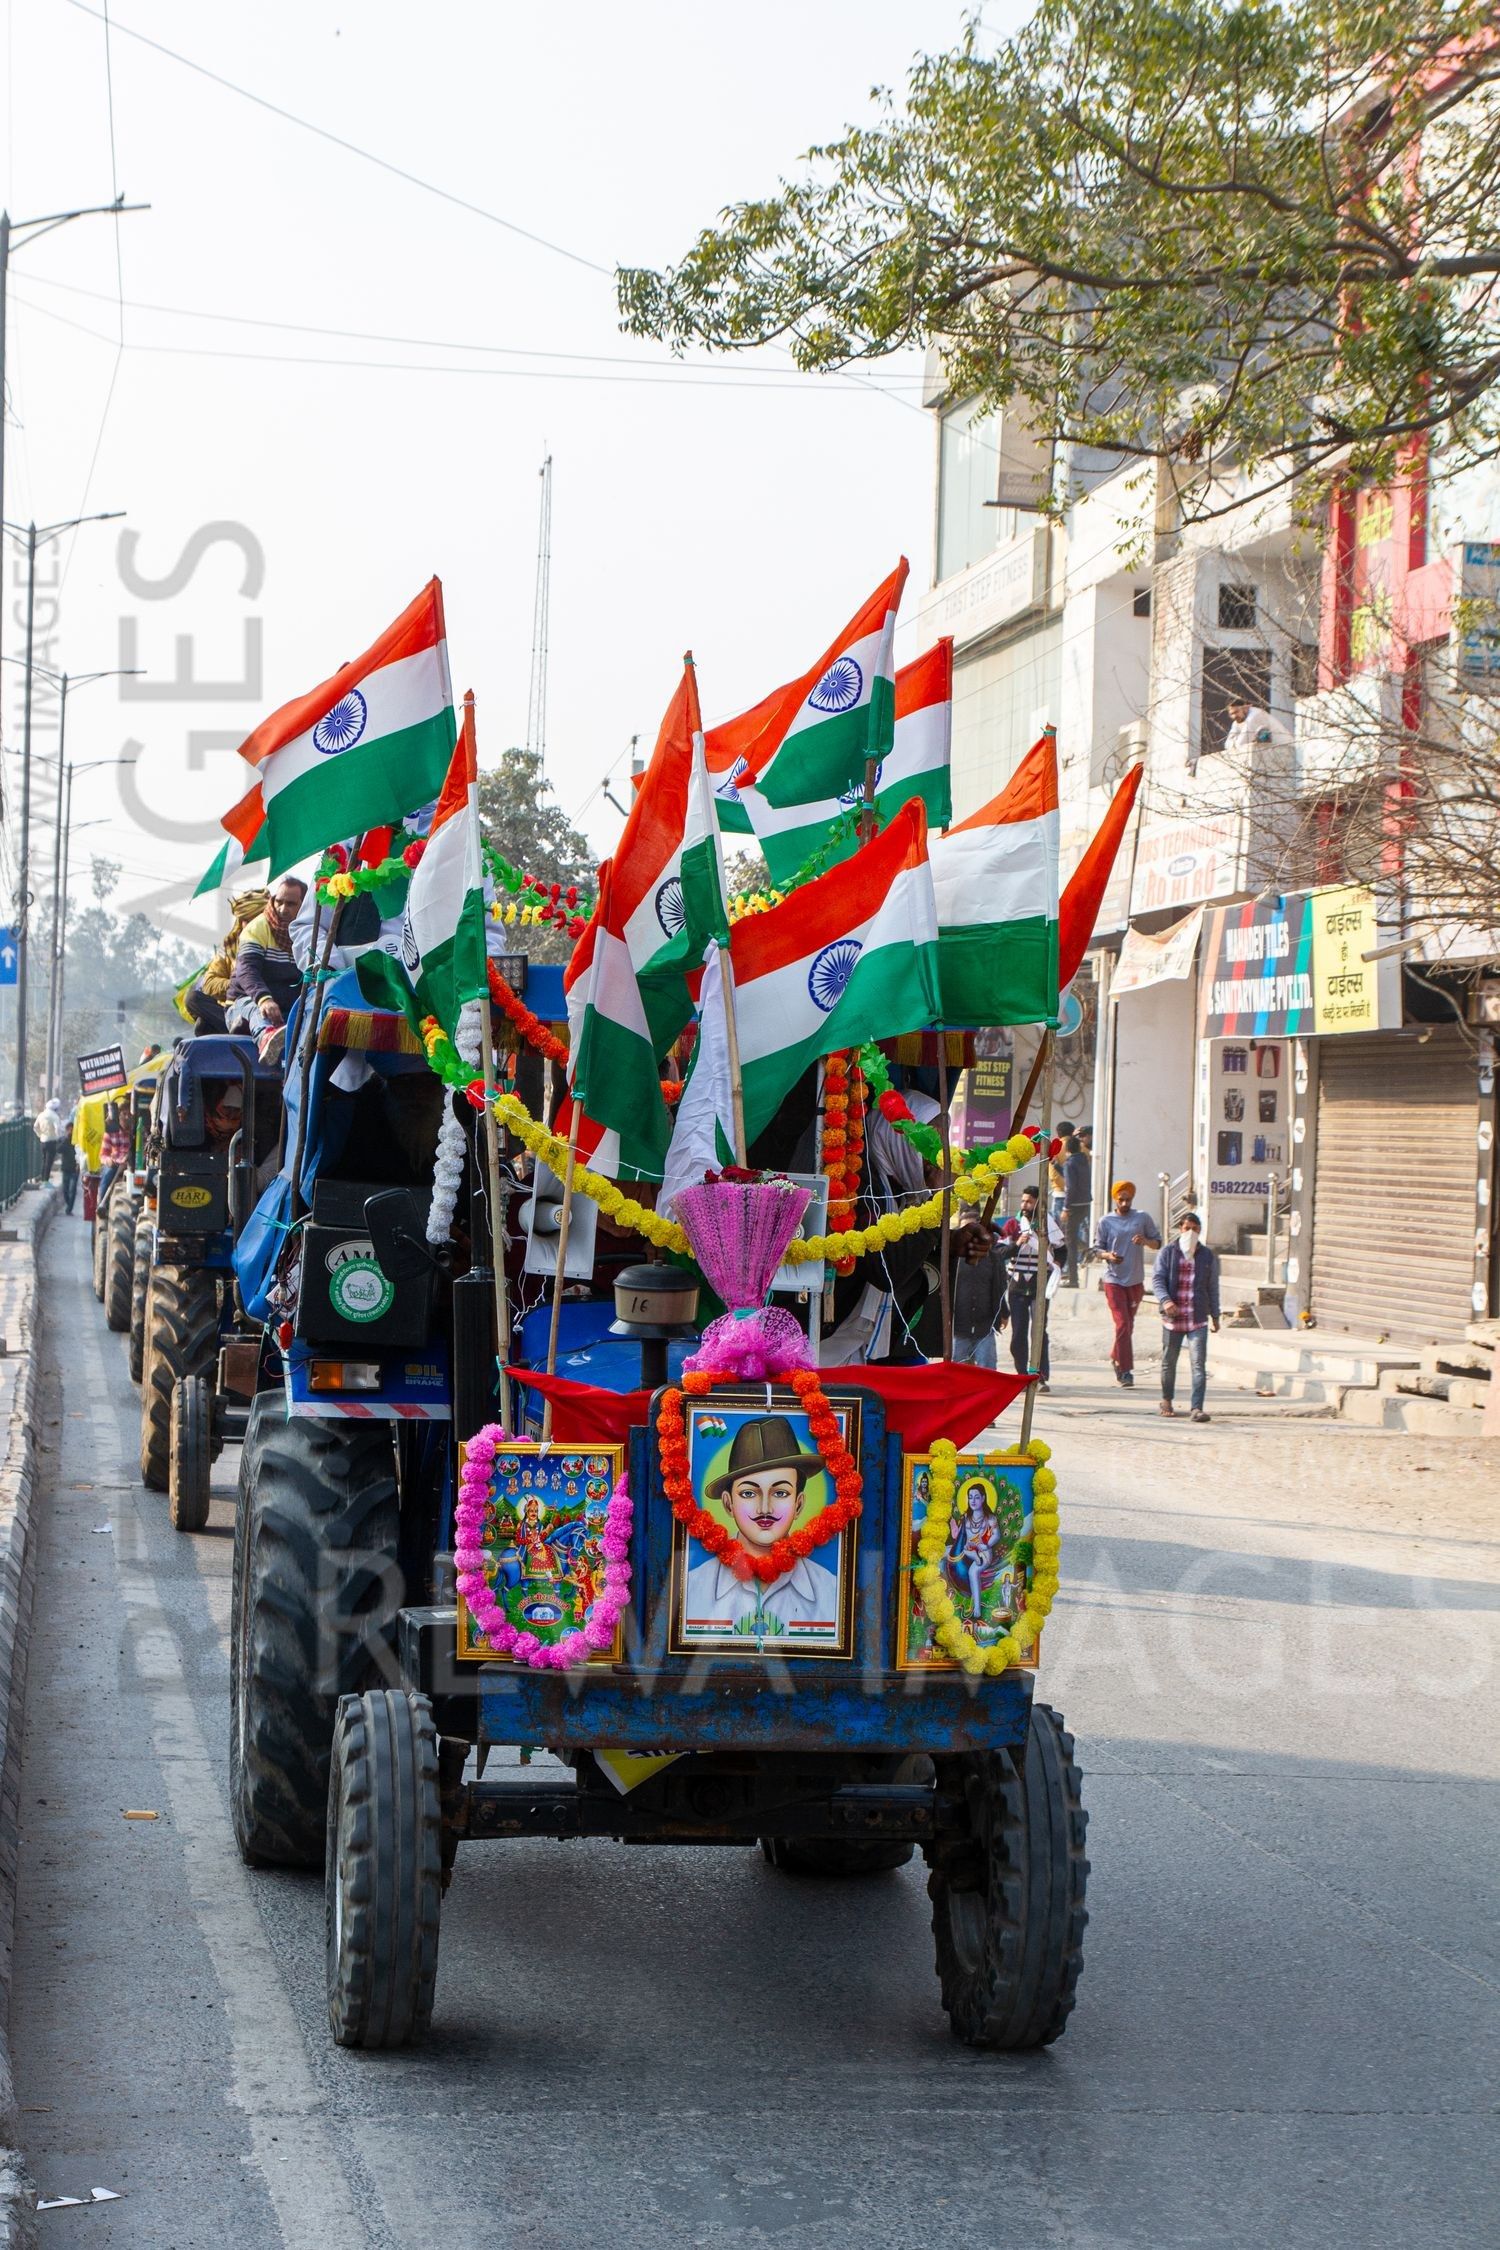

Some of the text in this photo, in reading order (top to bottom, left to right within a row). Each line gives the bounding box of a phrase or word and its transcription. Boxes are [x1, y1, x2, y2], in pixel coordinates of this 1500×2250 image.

[1265, 921, 1290, 959] TILES
[80, 1051, 121, 1071] WITHDRAW
[976, 1061, 1011, 1073] IRST STEP
[96, 1064, 121, 1077] FARMING
[975, 1074, 1005, 1087] FITNESS
[176, 1191, 206, 1201] HARI
[334, 1249, 376, 1266] AM
[631, 1296, 649, 1313] 16
[404, 1364, 444, 1377] OIL
[405, 1379, 444, 1387] BRAKE
